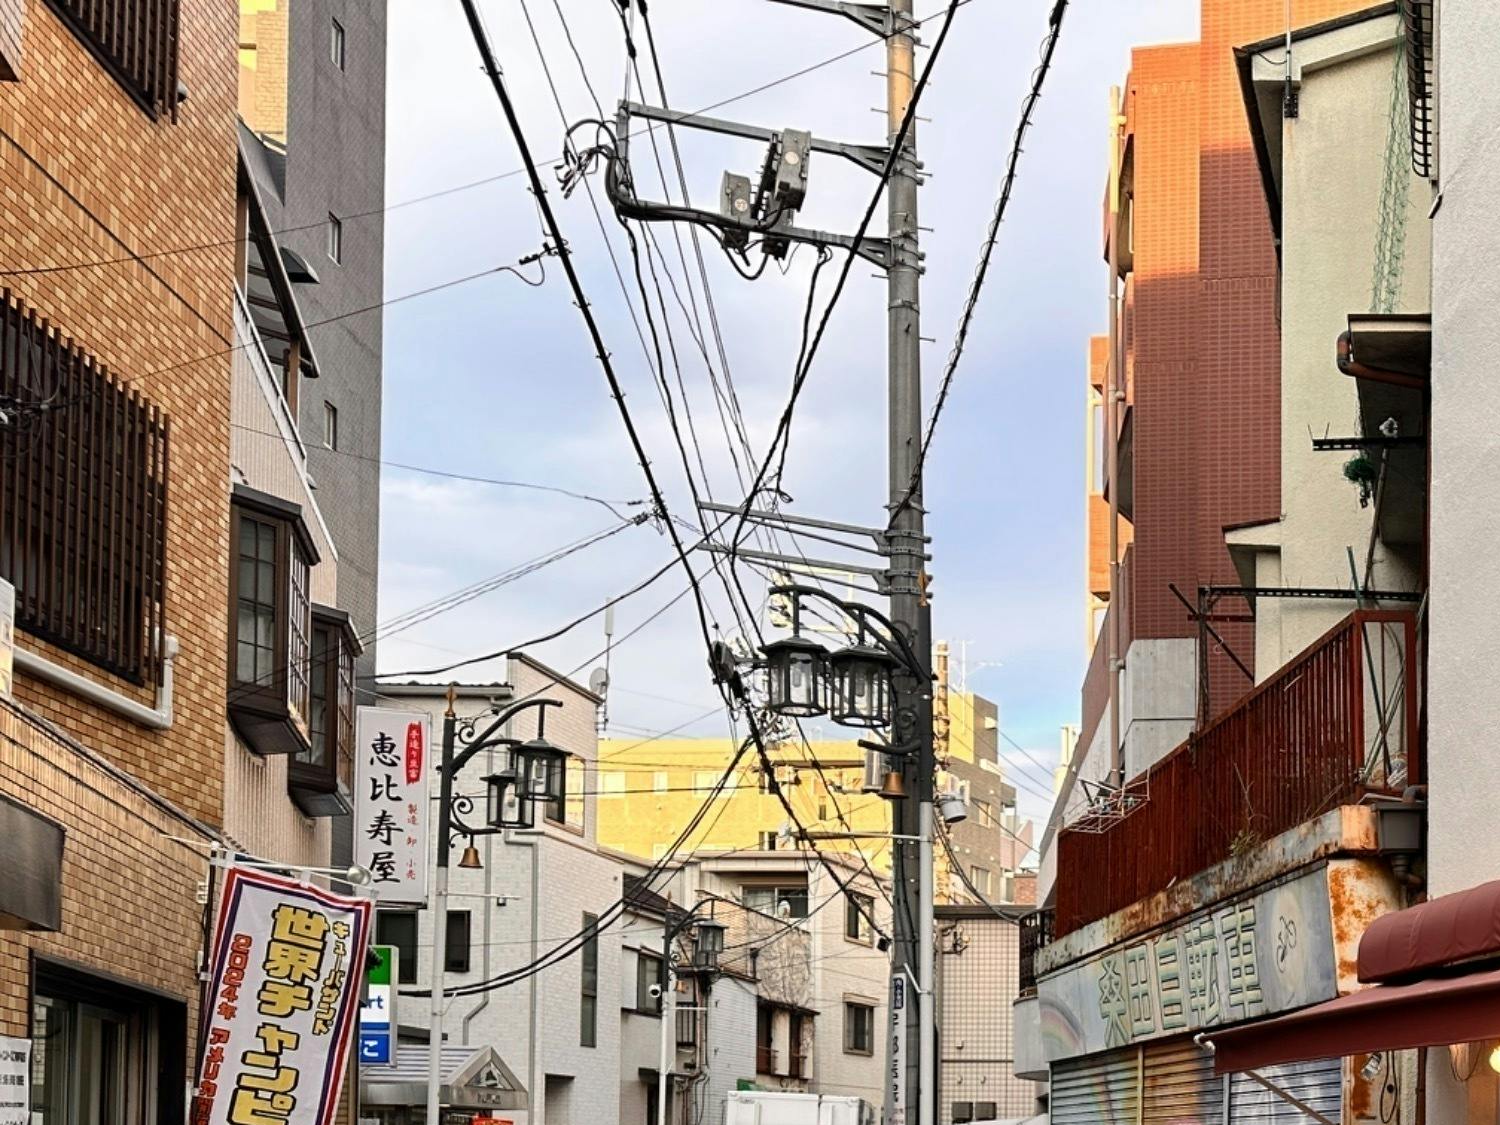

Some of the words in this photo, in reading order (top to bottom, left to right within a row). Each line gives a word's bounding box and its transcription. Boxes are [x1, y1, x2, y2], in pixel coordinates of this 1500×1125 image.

[366, 732, 404, 883] 恵比寿屋
[217, 932, 253, 1021] 2024年
[311, 920, 351, 1035] キューバサンド
[1099, 901, 1264, 1048] 桑田自転車
